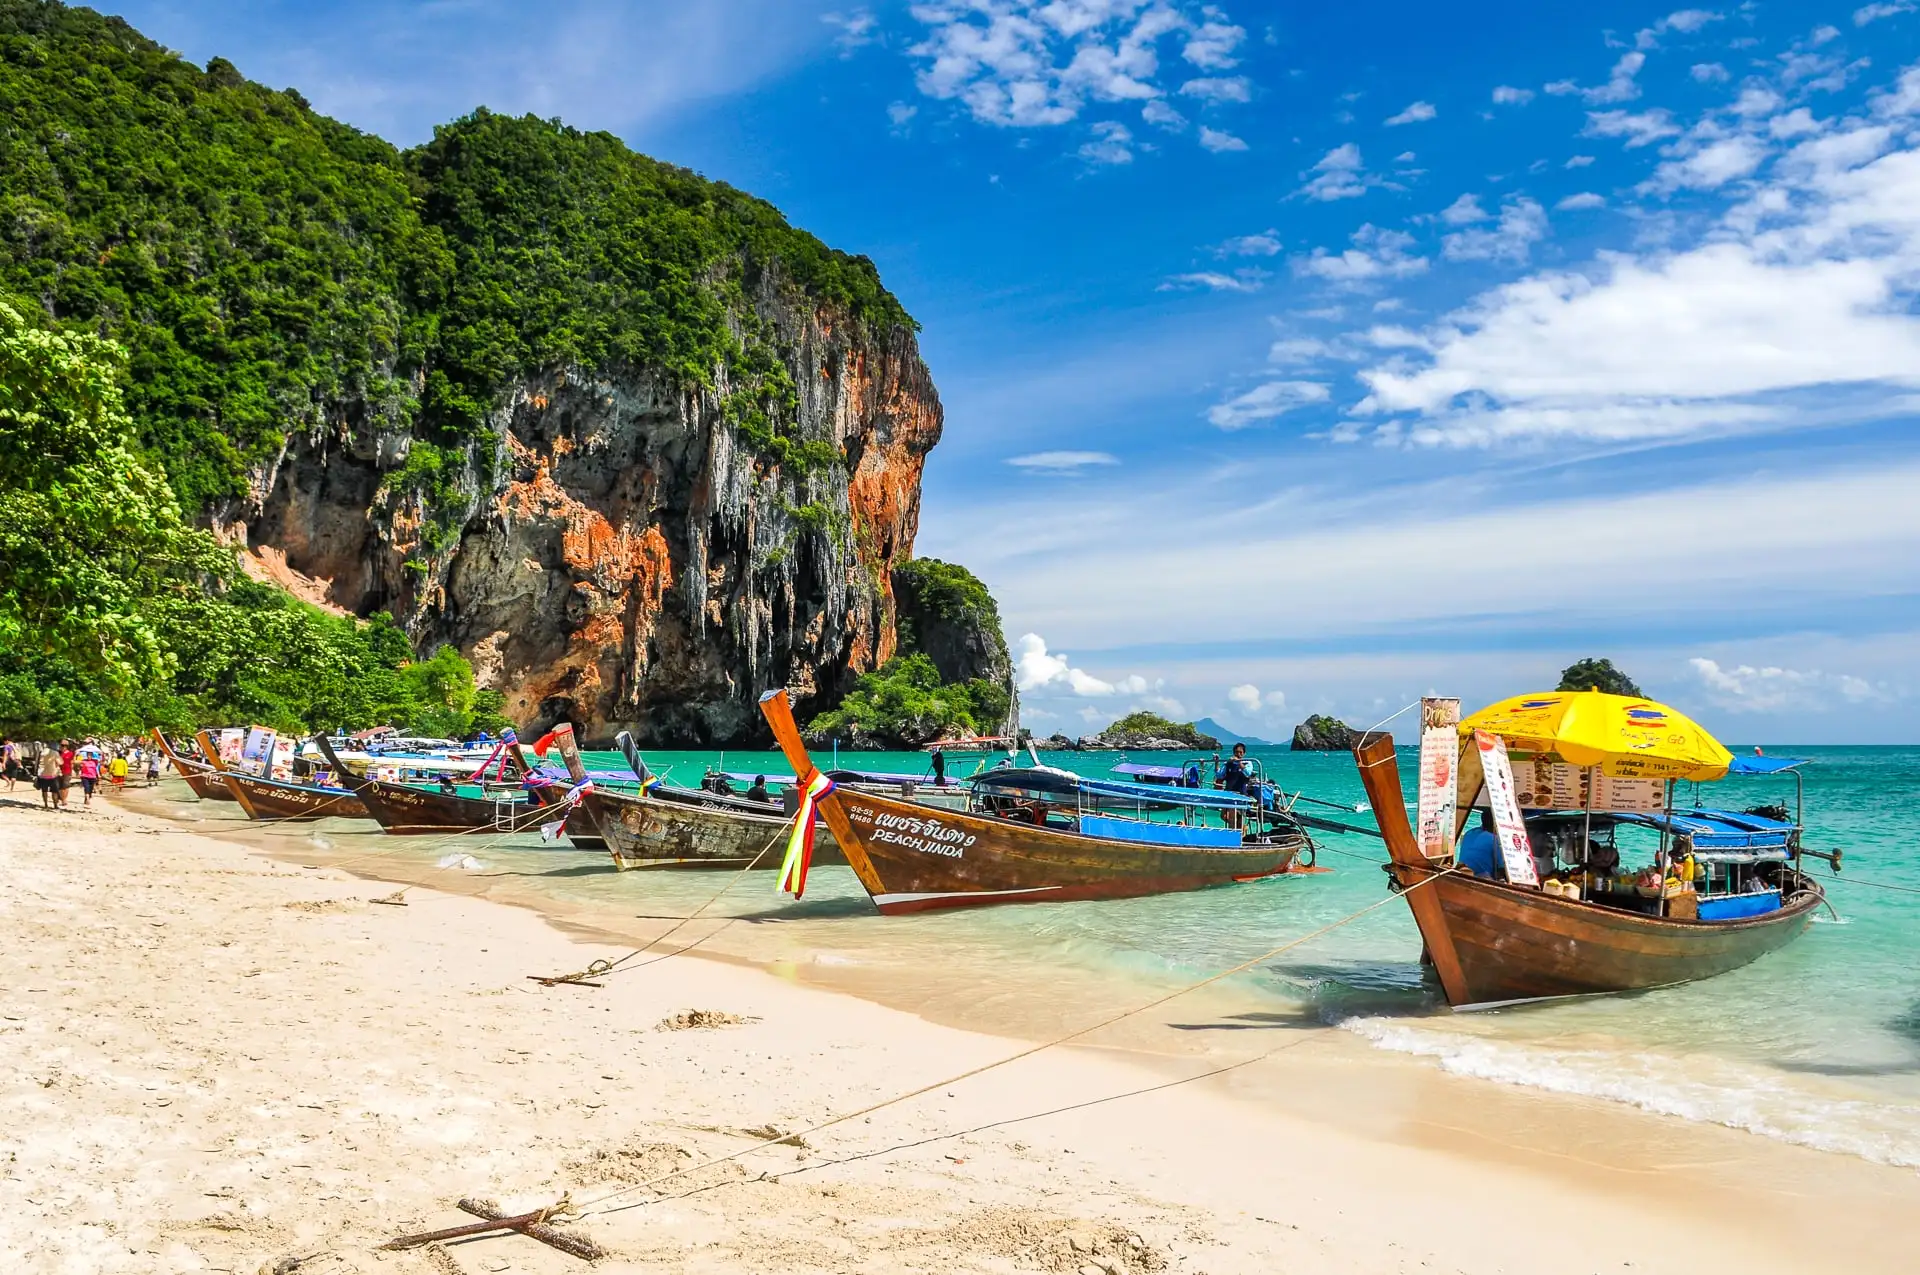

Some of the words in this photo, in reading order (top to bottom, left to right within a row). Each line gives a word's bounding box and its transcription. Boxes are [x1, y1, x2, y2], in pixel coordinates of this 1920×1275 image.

[1424, 705, 1452, 723] Drinks
[849, 813, 872, 824] 81480
[850, 805, 874, 817] 52-52
[869, 829, 964, 859] PEACHJINDA
